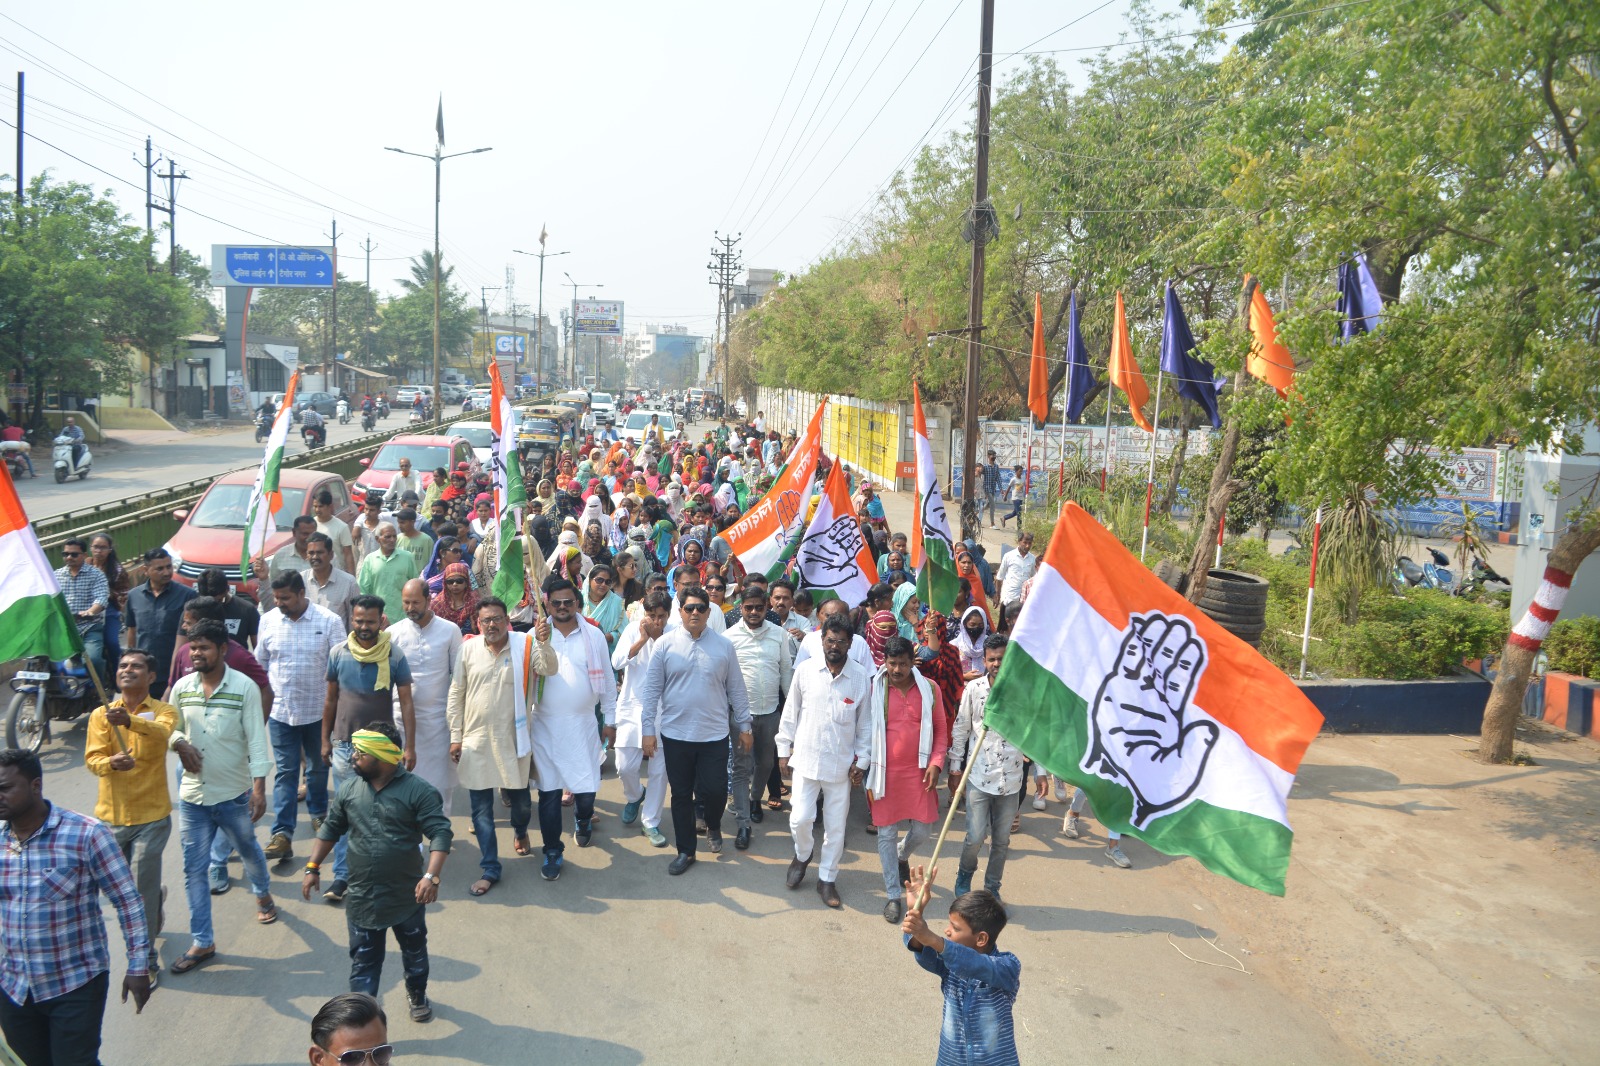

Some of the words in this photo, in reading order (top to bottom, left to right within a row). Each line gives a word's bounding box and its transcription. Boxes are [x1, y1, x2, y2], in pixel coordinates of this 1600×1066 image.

[293, 270, 307, 278] नगर
[497, 336, 523, 353] GK
[903, 466, 915, 474] ENT
